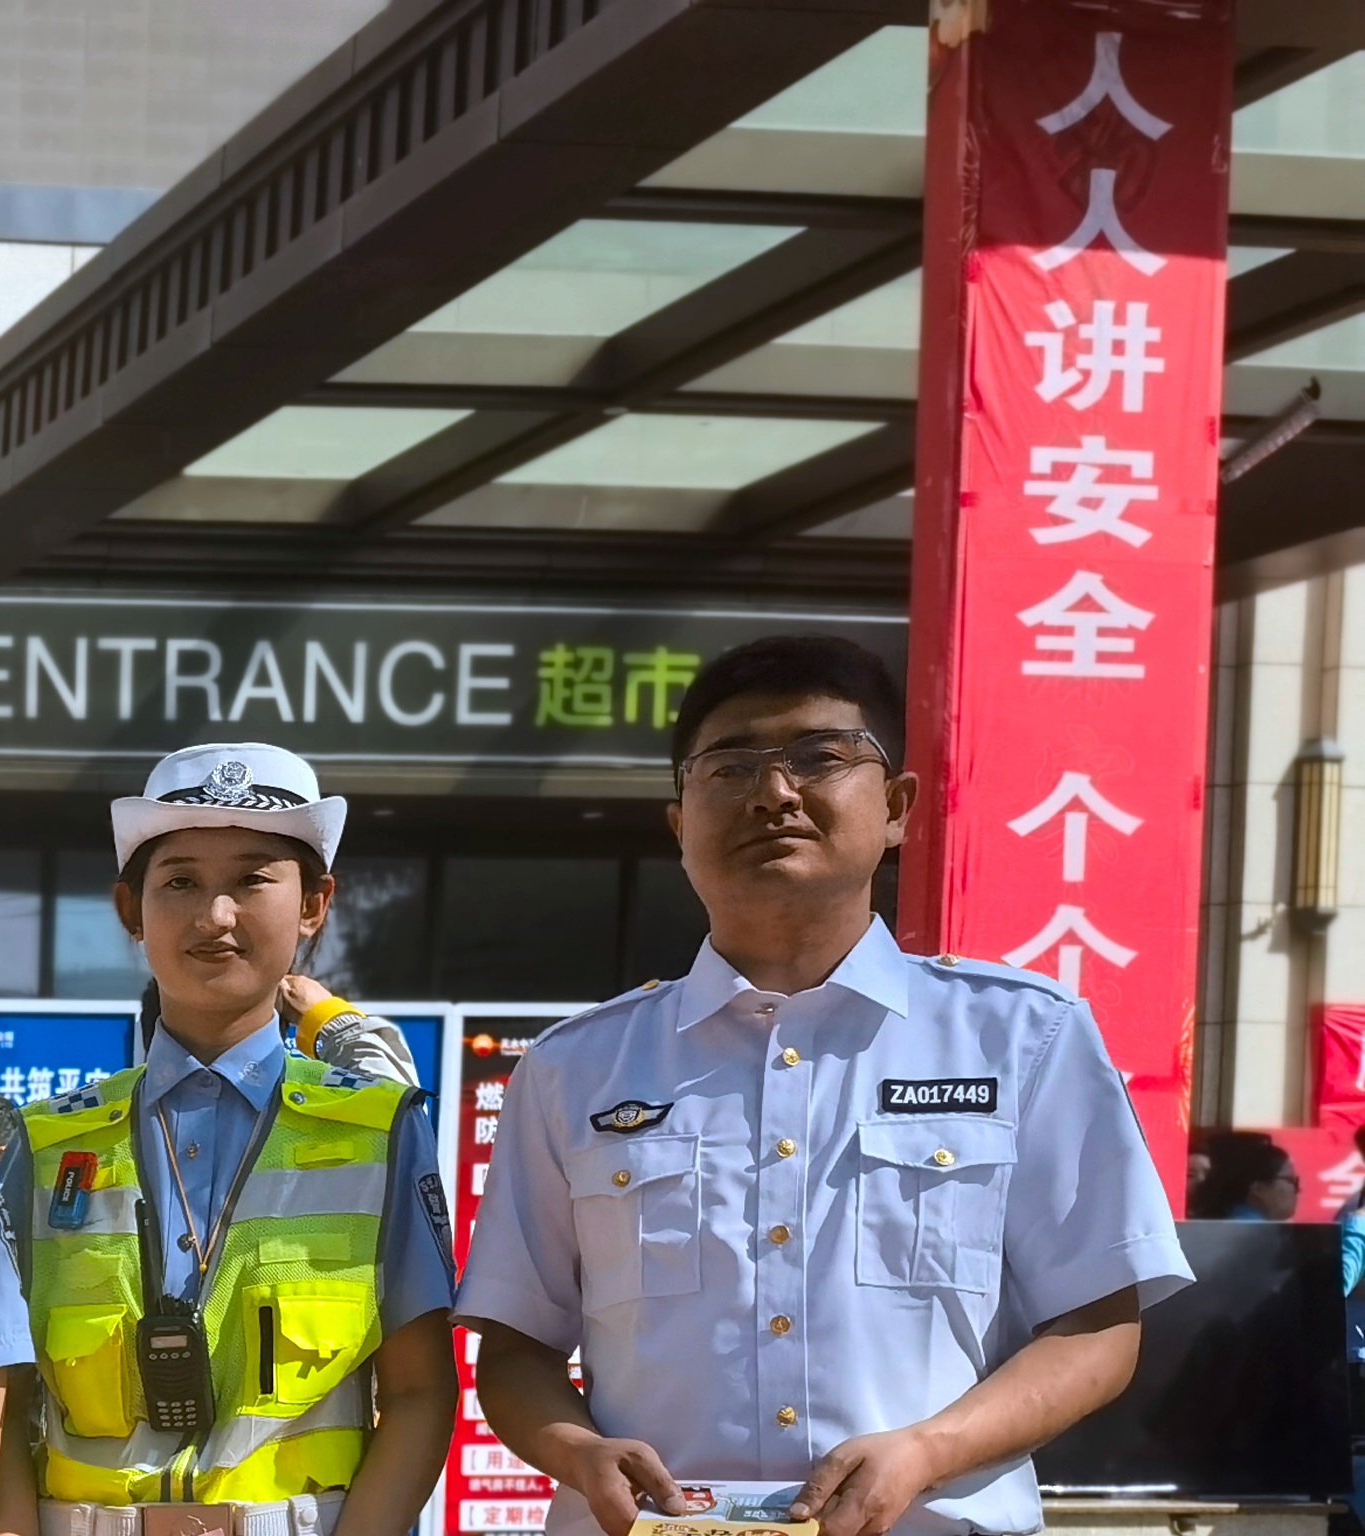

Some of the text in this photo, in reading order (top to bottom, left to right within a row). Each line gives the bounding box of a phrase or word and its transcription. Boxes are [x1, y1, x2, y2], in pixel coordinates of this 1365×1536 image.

[1015, 31, 1175, 681] 人人讲安全
[534, 642, 701, 731] 超市
[890, 1084, 990, 1105] ZA017449
